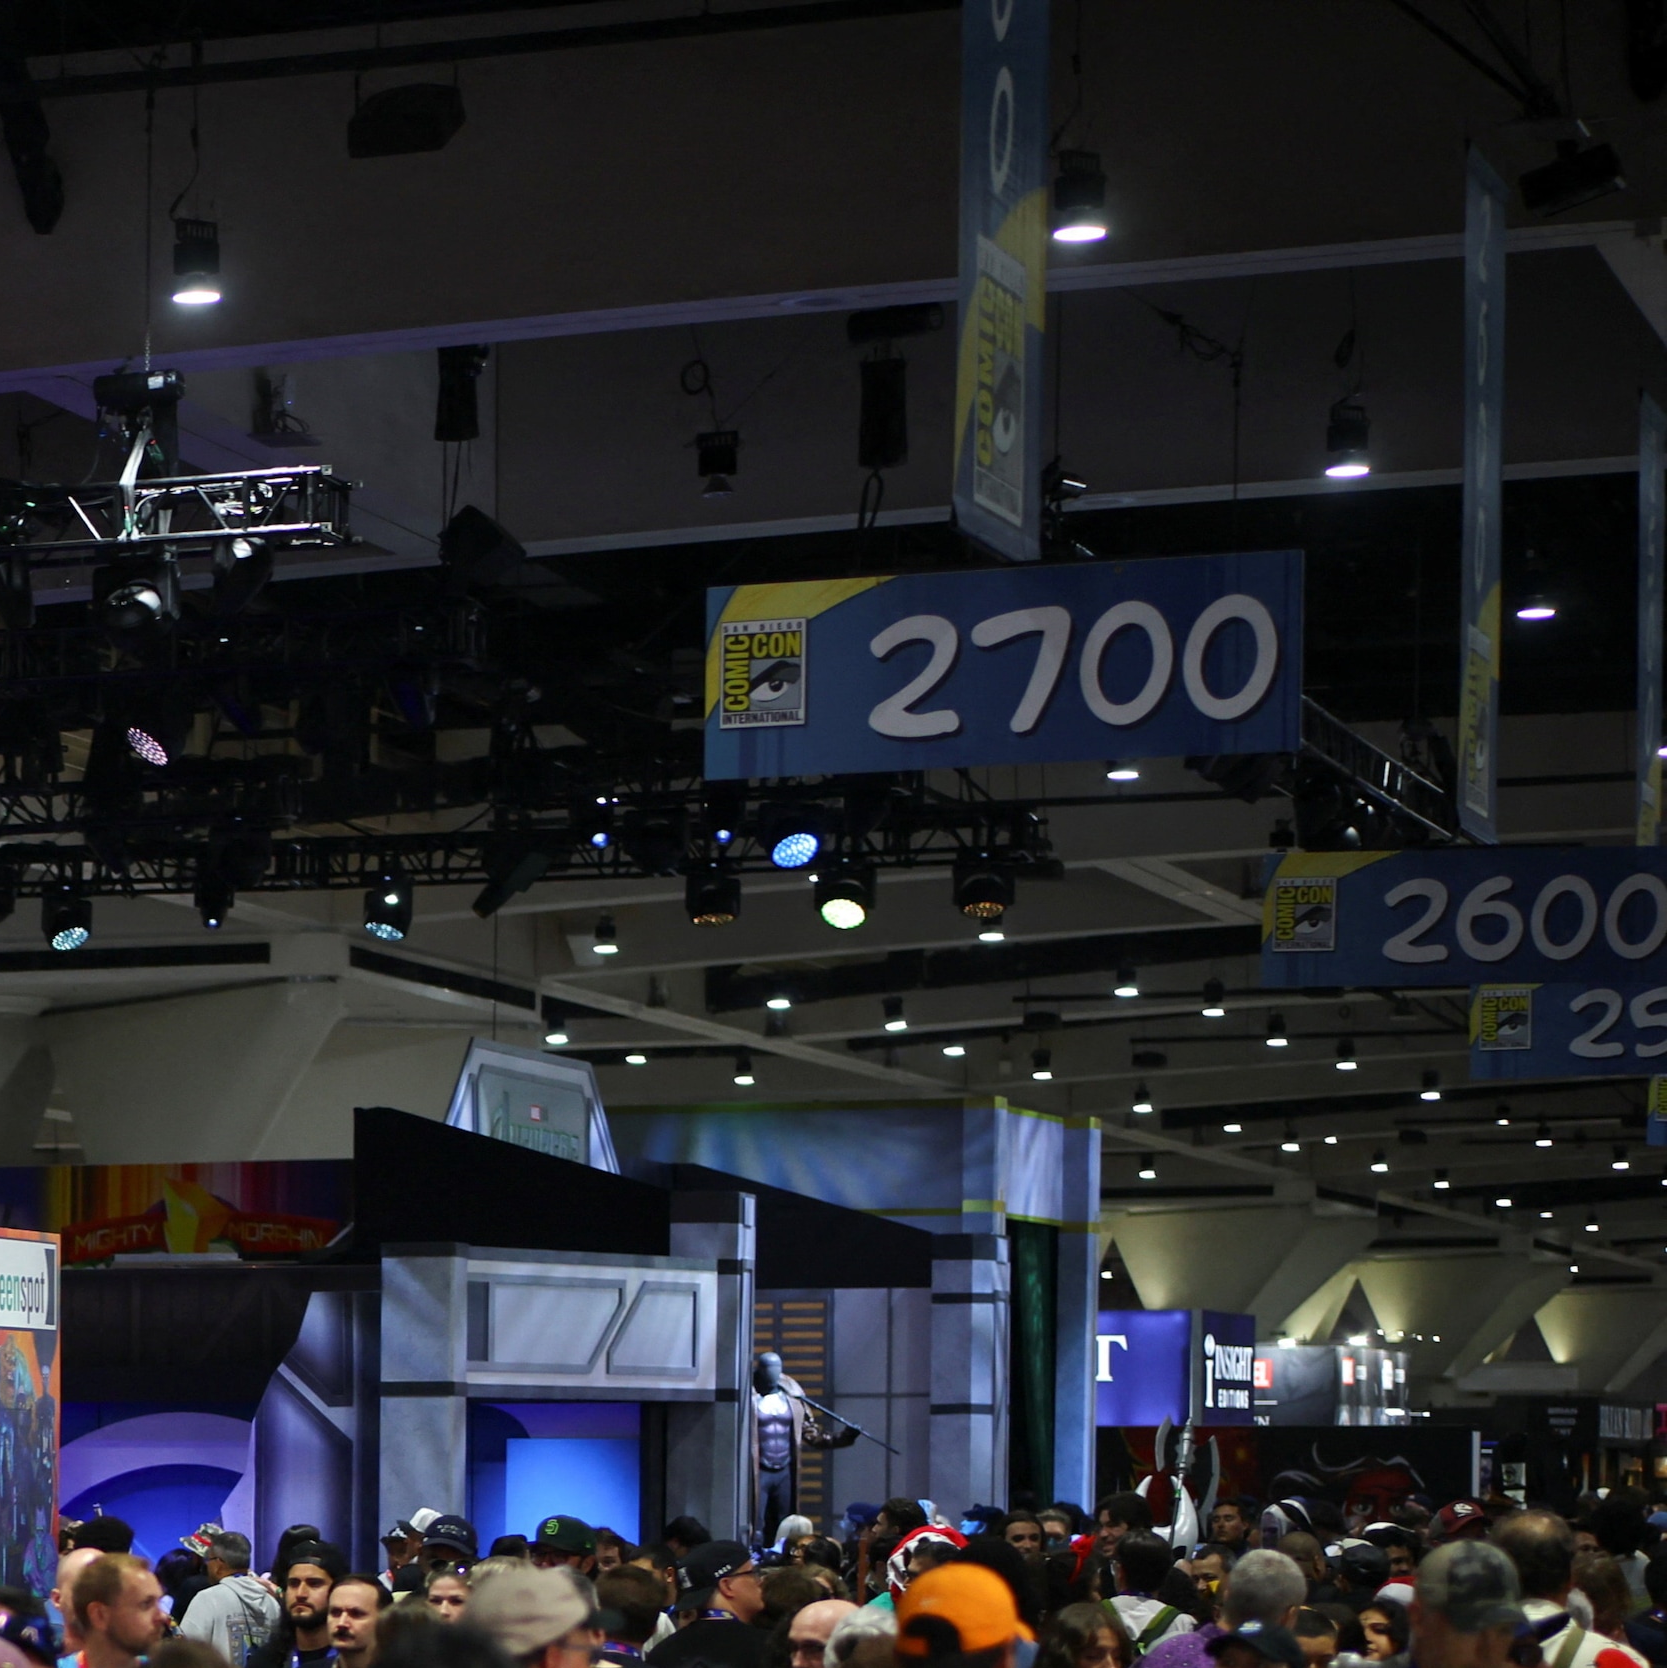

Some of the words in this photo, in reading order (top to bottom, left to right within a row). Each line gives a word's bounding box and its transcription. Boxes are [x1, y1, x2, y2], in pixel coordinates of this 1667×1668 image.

[723, 624, 750, 634] SAN
[759, 621, 803, 632] DIEGO
[751, 631, 802, 658] CON
[724, 635, 750, 711] COMIC
[869, 594, 1279, 738] 2700
[722, 710, 801, 726] INTERNATIONAL
[1297, 885, 1334, 904] CON
[1276, 886, 1297, 941] COMIC
[1382, 872, 1667, 964] 2600
[1481, 997, 1498, 1042] COMIC
[1499, 997, 1529, 1013] CON
[74, 1221, 158, 1254] MIGHTY
[228, 1220, 327, 1249] MORPHIN
[1215, 1344, 1253, 1382] INSIGHT
[1218, 1388, 1250, 1409] EDITIONS
